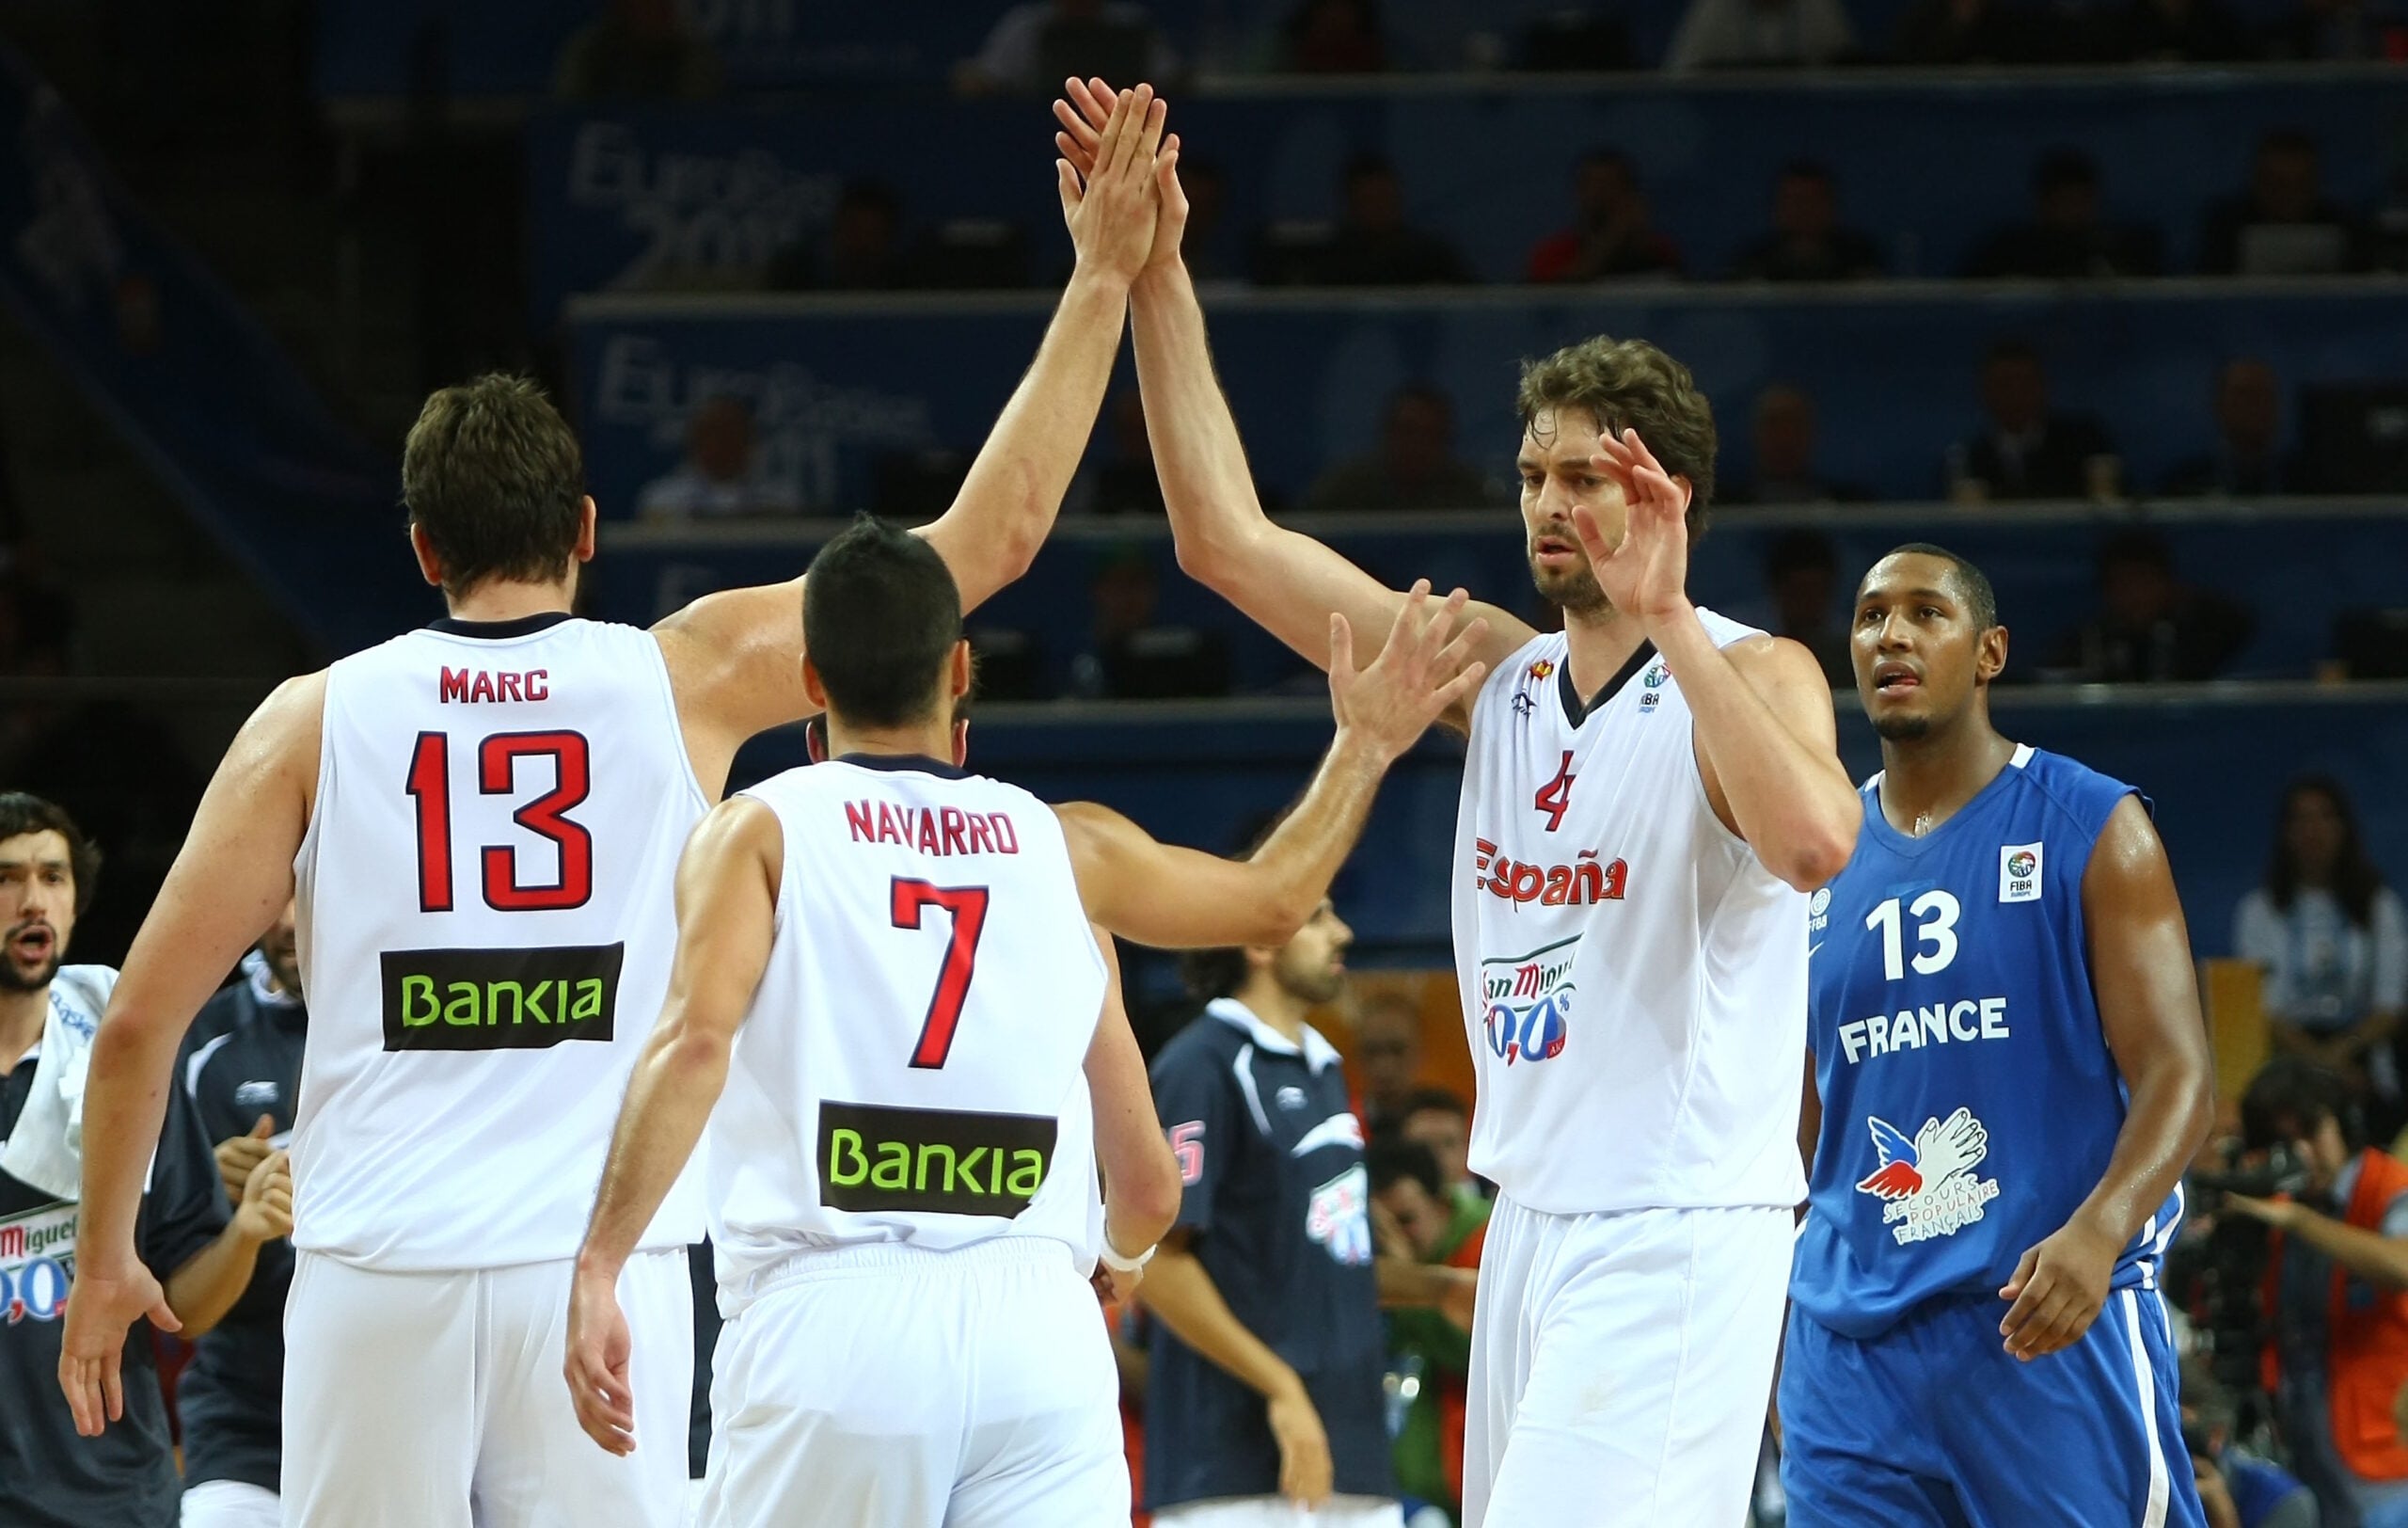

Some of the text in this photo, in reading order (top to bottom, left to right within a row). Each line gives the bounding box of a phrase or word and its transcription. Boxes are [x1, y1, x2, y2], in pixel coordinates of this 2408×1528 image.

[439, 666, 548, 703] MARC
[1534, 749, 1577, 832] 4
[405, 729, 592, 913] 13
[844, 798, 1020, 857] NAVARRO
[1476, 836, 1629, 914] España
[2009, 879, 2033, 892] FIBA
[1865, 889, 1960, 980] 13
[402, 974, 602, 1028] Bankia
[890, 874, 990, 1070] 7
[1838, 997, 2010, 1064] FRANCE
[830, 1128, 1043, 1196] Bankia
[1884, 1176, 1977, 1221] SECOURS
[1894, 1205, 1982, 1242] FRANÇAIS
[1910, 1181, 1998, 1224] POPULAIRE
[0, 1213, 78, 1258] Miguel
